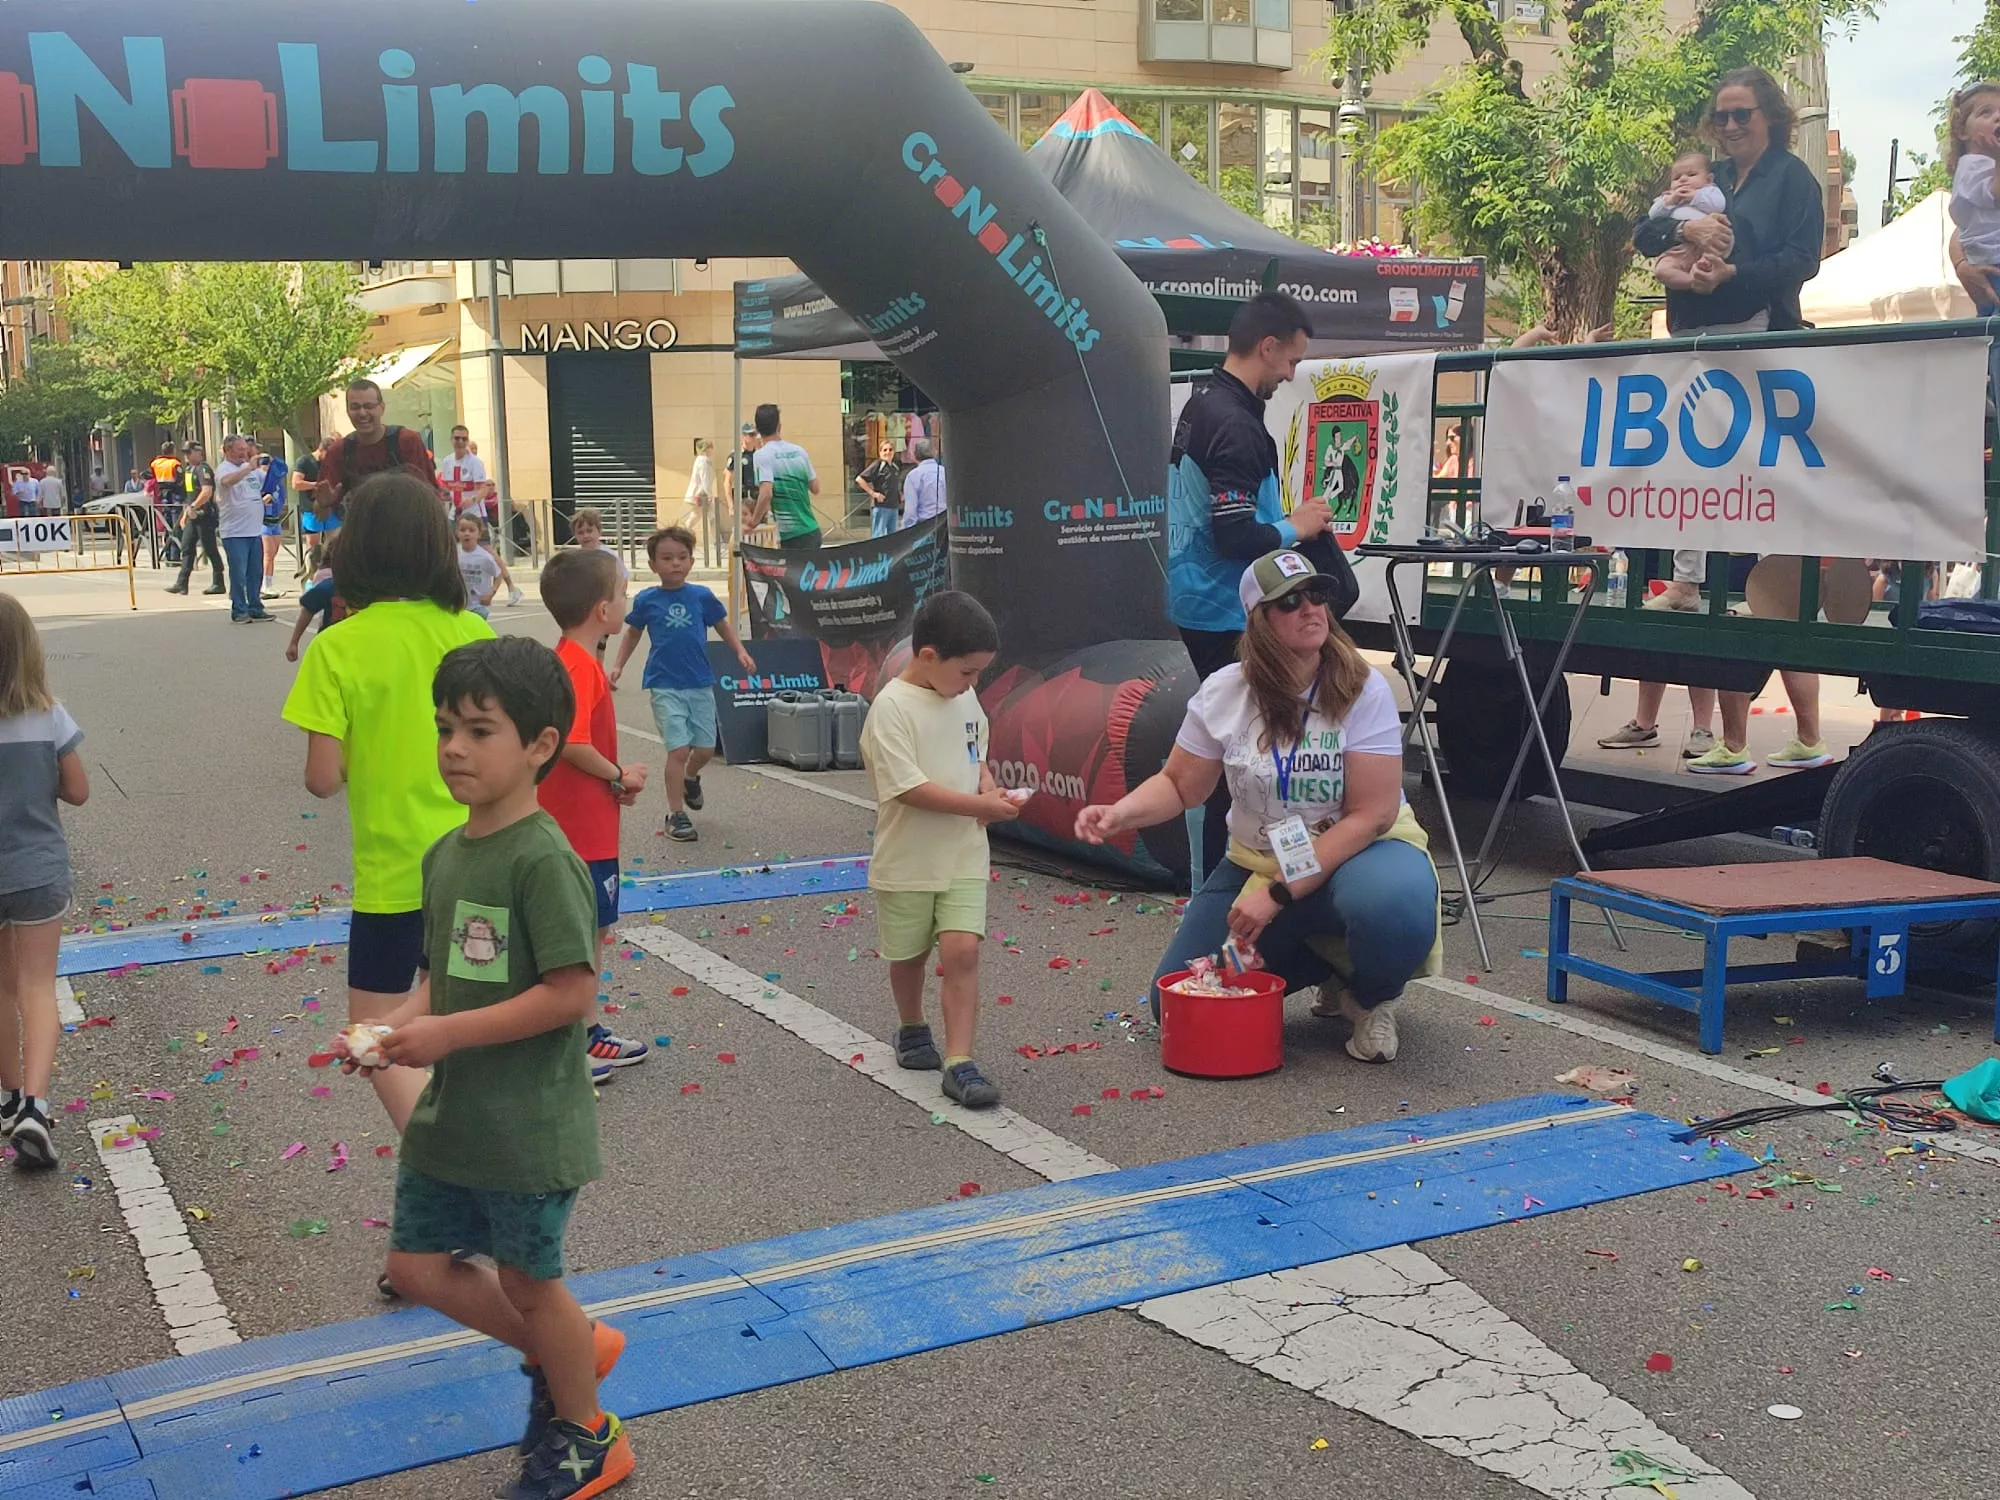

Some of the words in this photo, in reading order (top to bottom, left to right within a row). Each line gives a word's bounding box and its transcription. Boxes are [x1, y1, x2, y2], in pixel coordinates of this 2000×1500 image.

[1376, 264, 1453, 276] CRONOLIMITS
[1454, 265, 1480, 277] LIVE
[520, 319, 678, 353] MANGO
[1313, 402, 1374, 419] RECREATIVA
[1580, 368, 1827, 468] IBOR
[1305, 424, 1317, 487] PEÑ
[1606, 473, 1777, 532] ortopedia
[20, 521, 69, 543] 10K
[1298, 731, 1341, 751] K-10K
[988, 758, 1087, 802] 2020.com
[1875, 934, 1901, 975] 3
